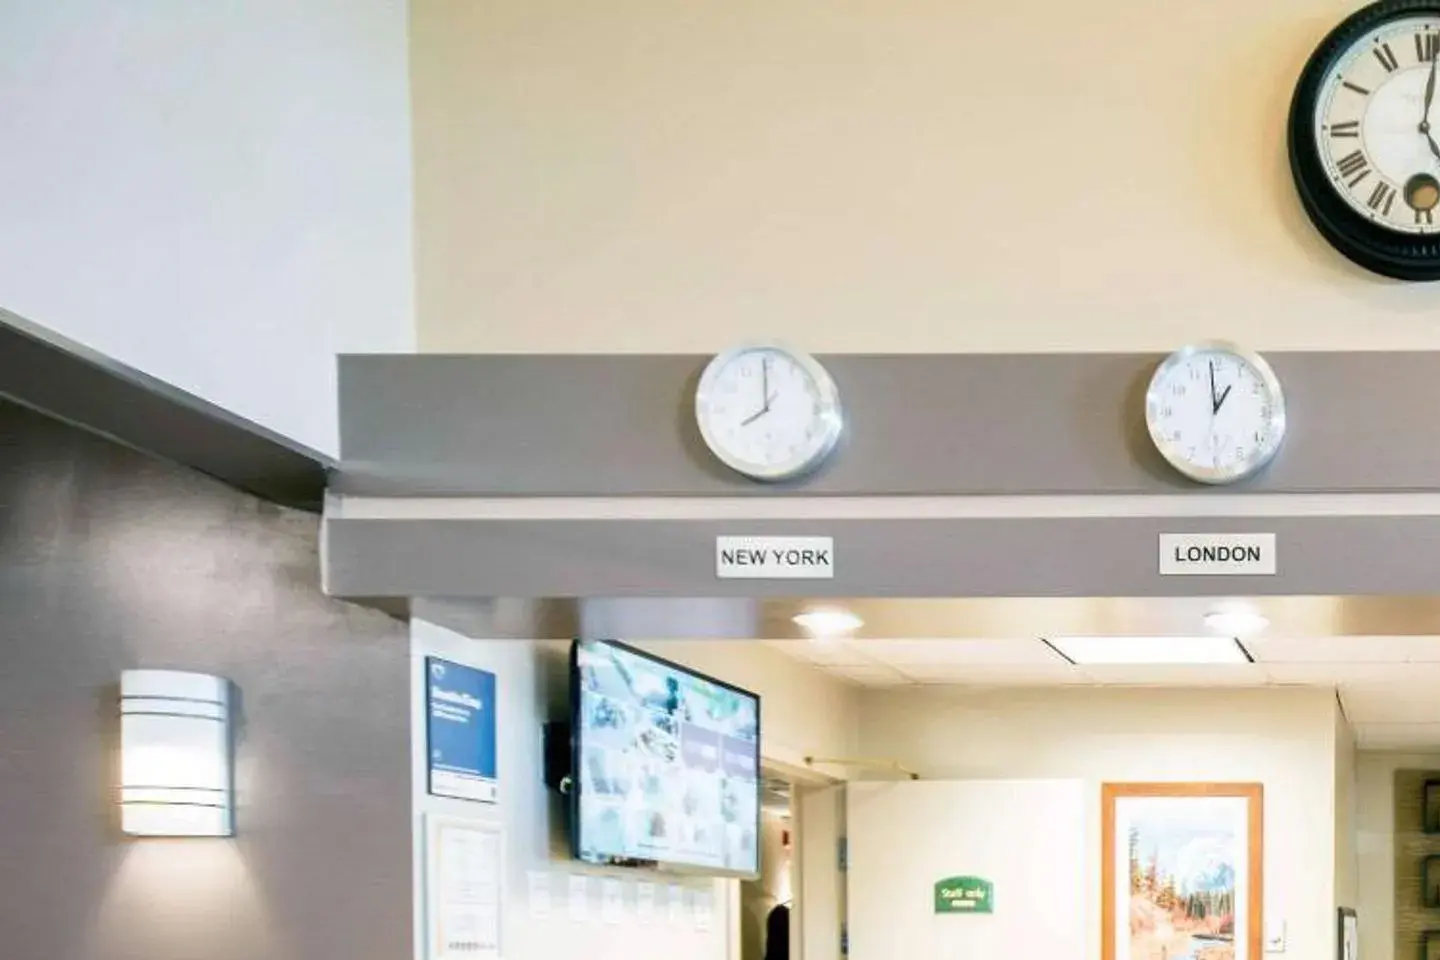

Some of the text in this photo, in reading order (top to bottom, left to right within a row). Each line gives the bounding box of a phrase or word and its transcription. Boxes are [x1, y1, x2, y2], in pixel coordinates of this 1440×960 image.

[721, 548, 830, 566] NEW YORK
[1174, 545, 1261, 562] LONDON
